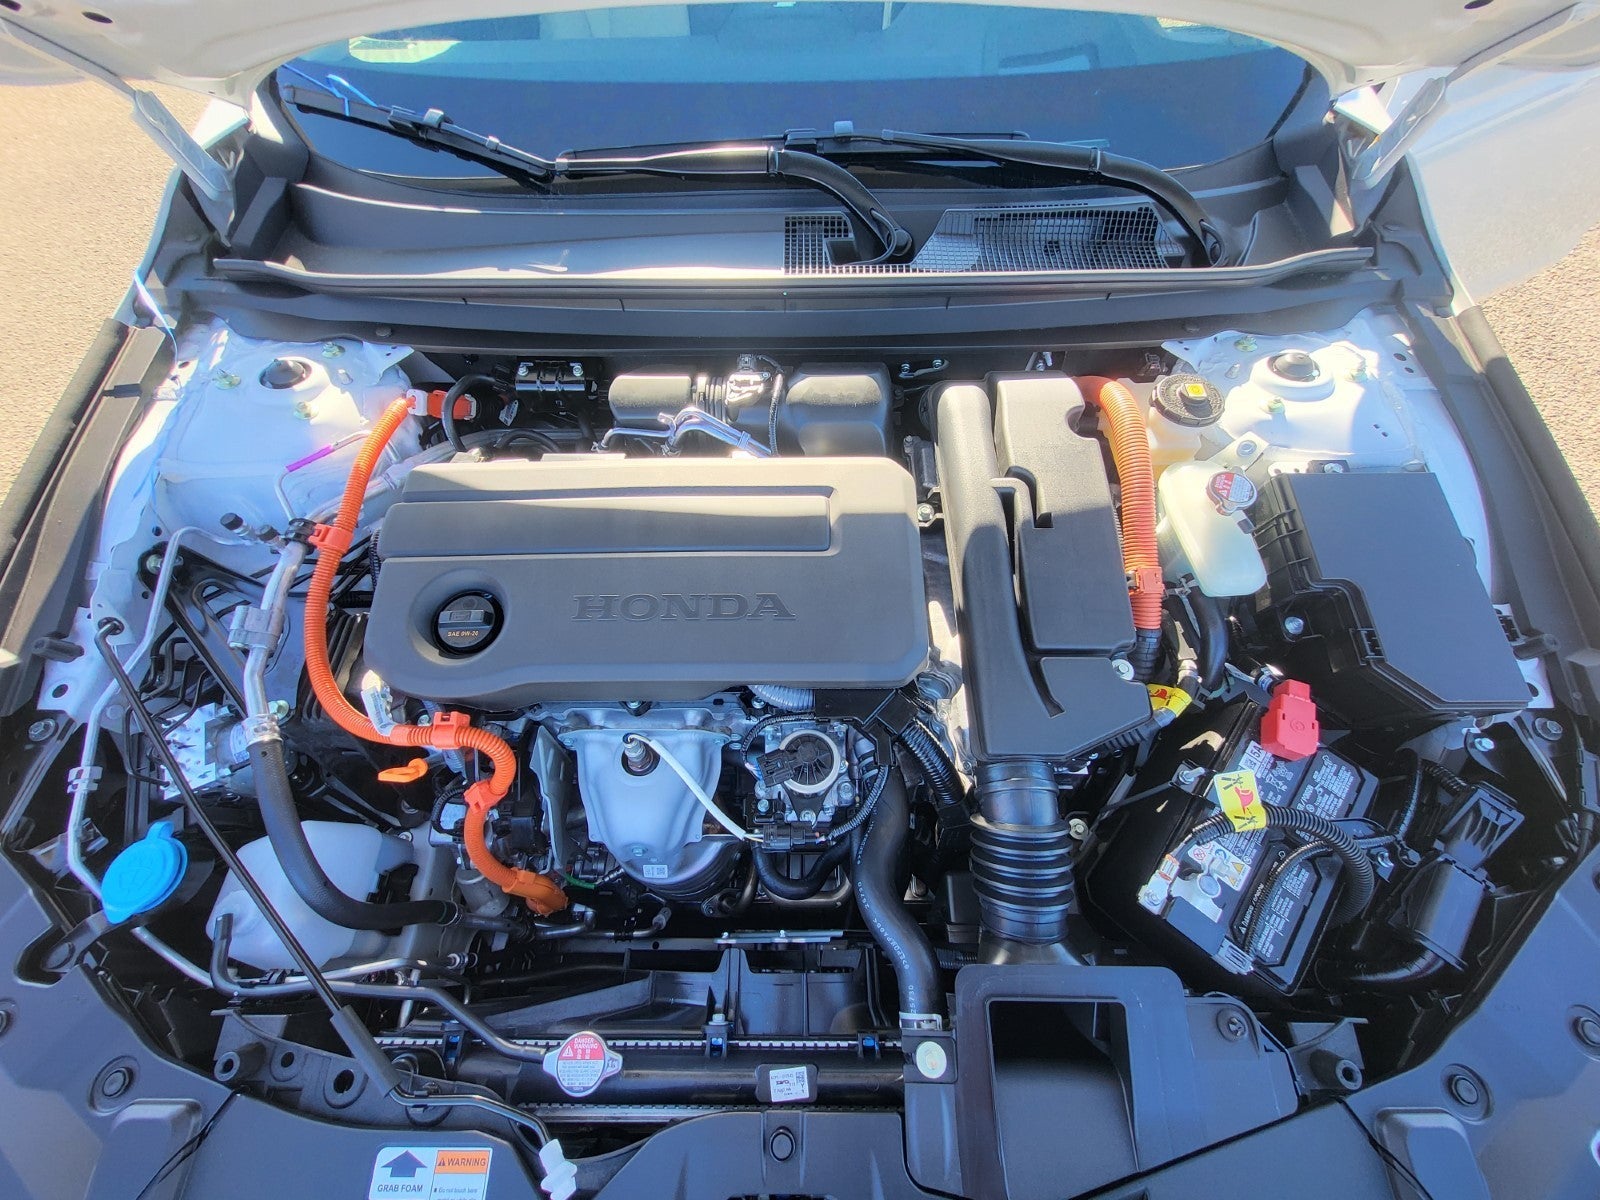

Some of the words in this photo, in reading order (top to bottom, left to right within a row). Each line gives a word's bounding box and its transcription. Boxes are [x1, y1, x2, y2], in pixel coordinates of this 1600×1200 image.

[571, 593, 797, 621] HONDA
[447, 1158, 486, 1167] WARNING
[377, 1184, 399, 1193] GRAB
[400, 1184, 423, 1192] FOAM
